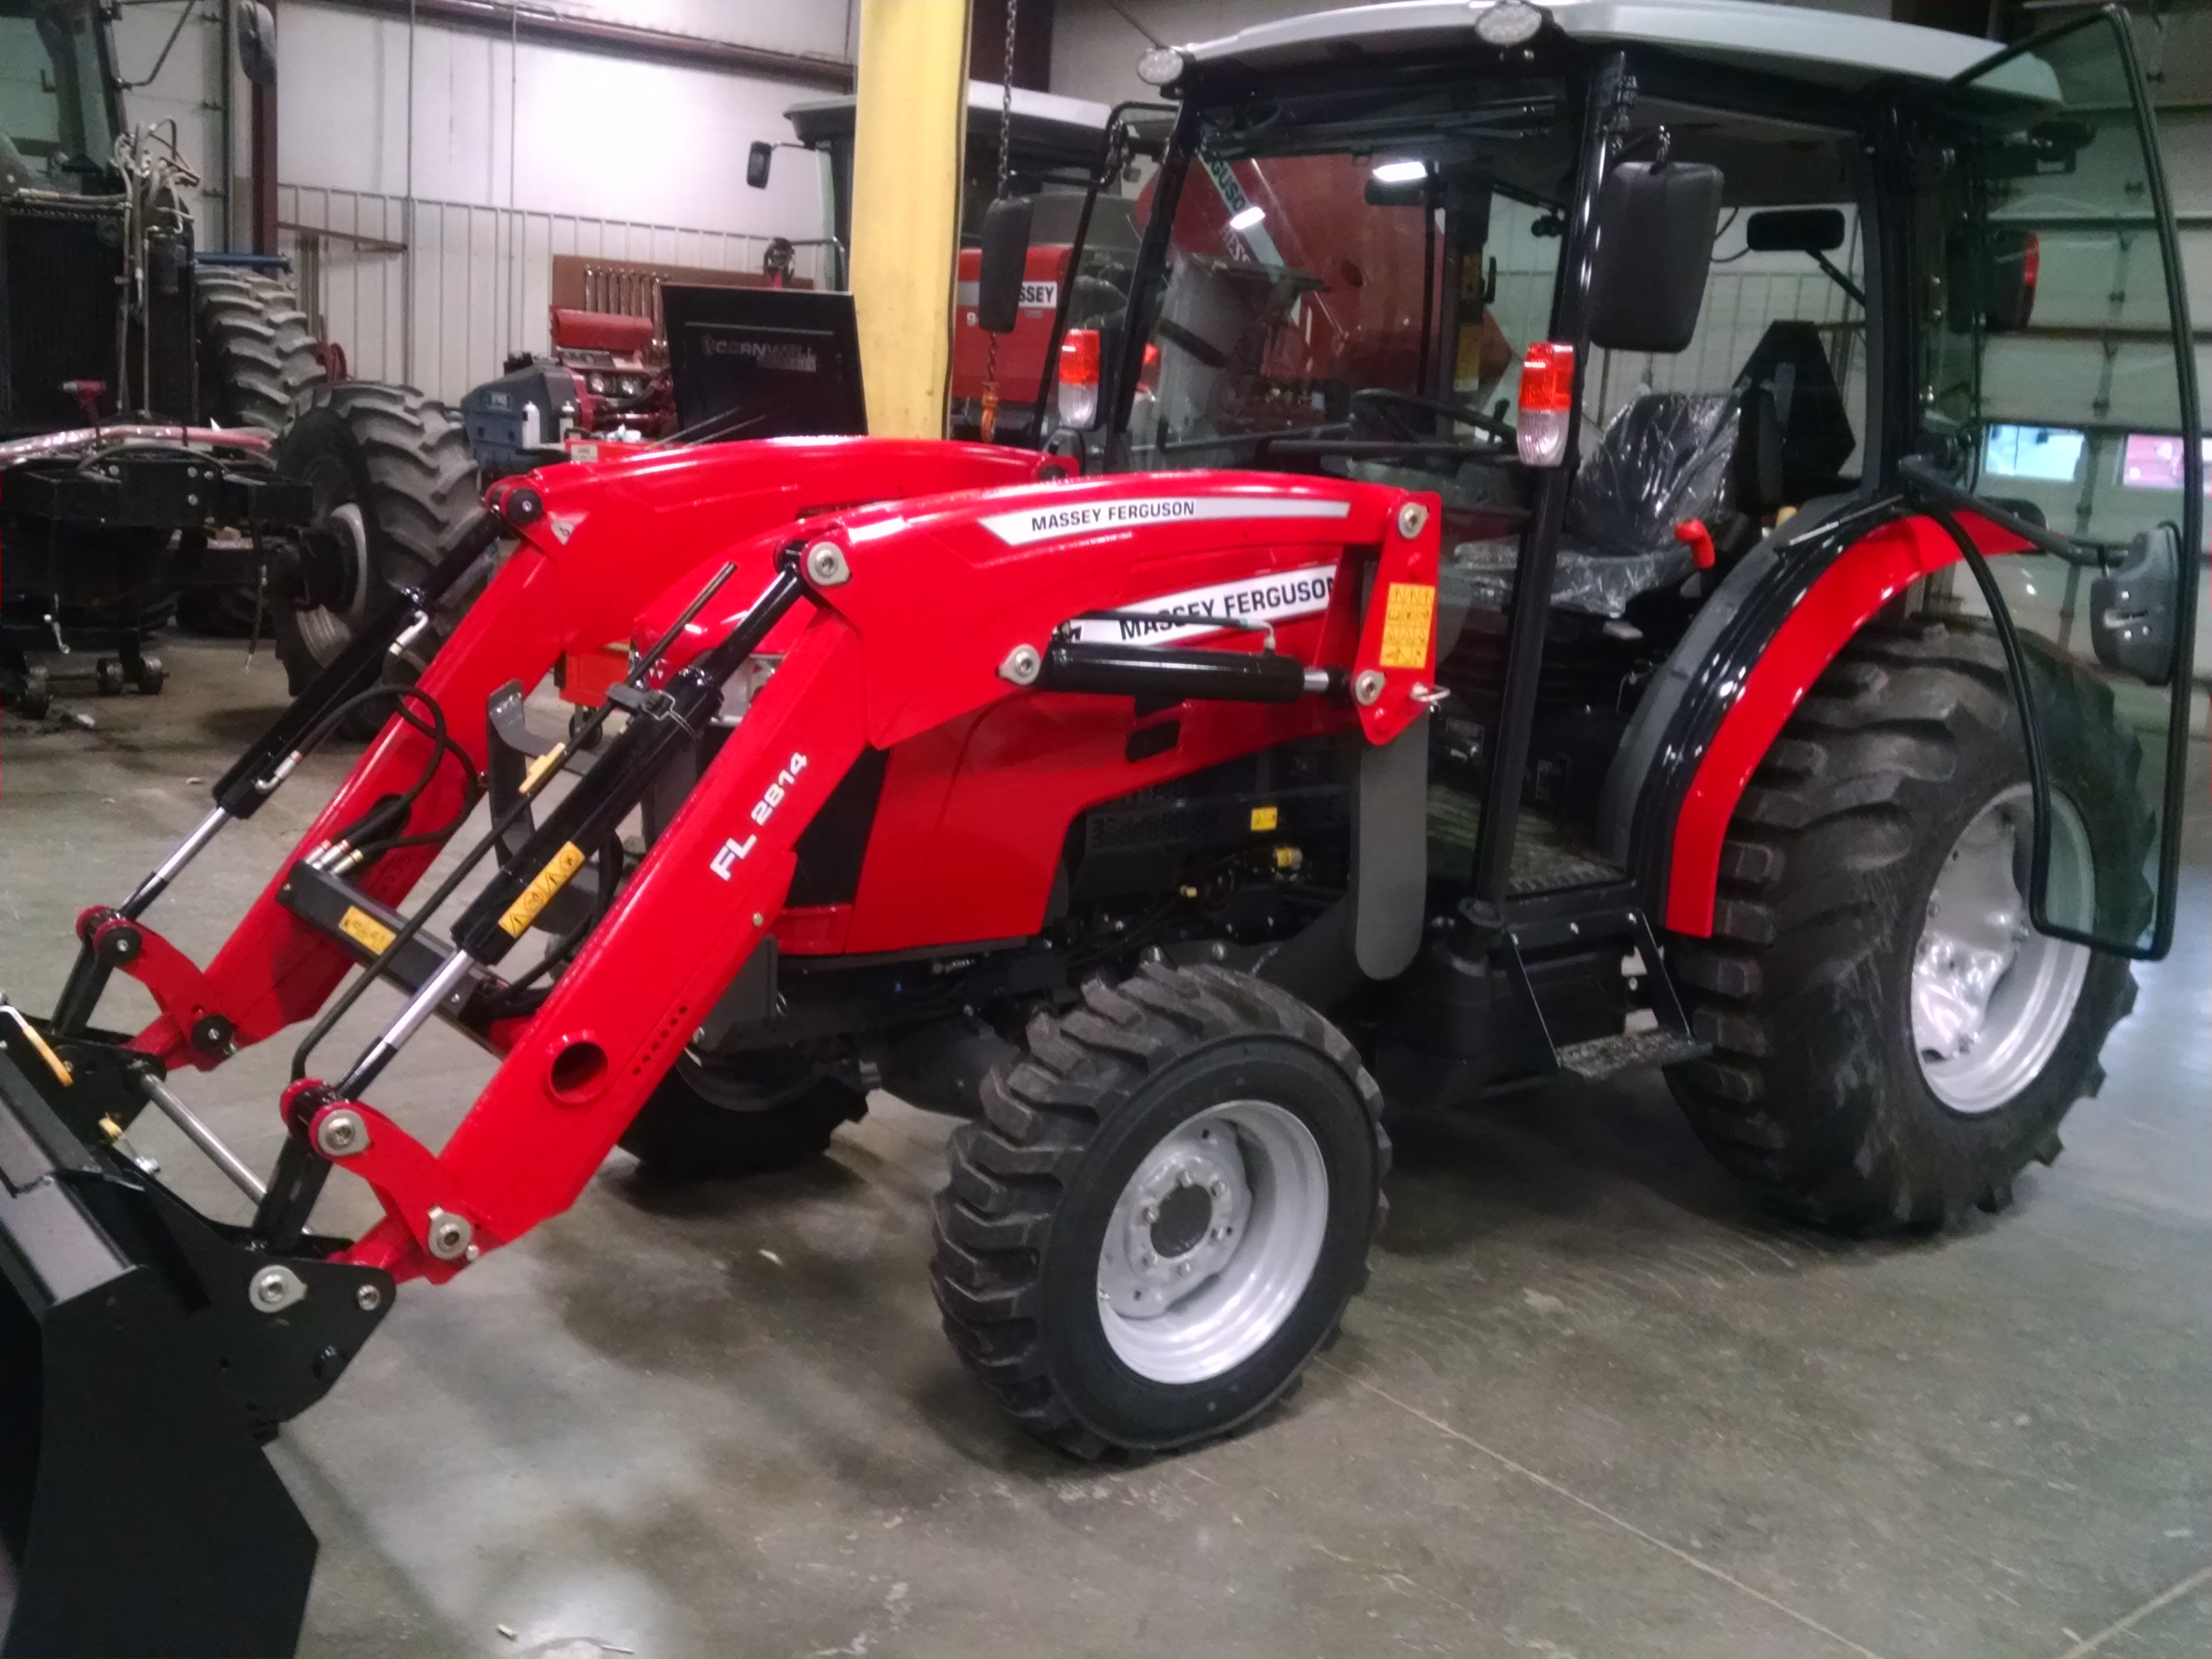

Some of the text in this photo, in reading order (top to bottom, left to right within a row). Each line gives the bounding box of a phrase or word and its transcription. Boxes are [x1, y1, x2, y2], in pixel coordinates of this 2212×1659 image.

[1031, 500, 1195, 532] MASSEY FERGUSON
[709, 751, 808, 882] FL 2814
